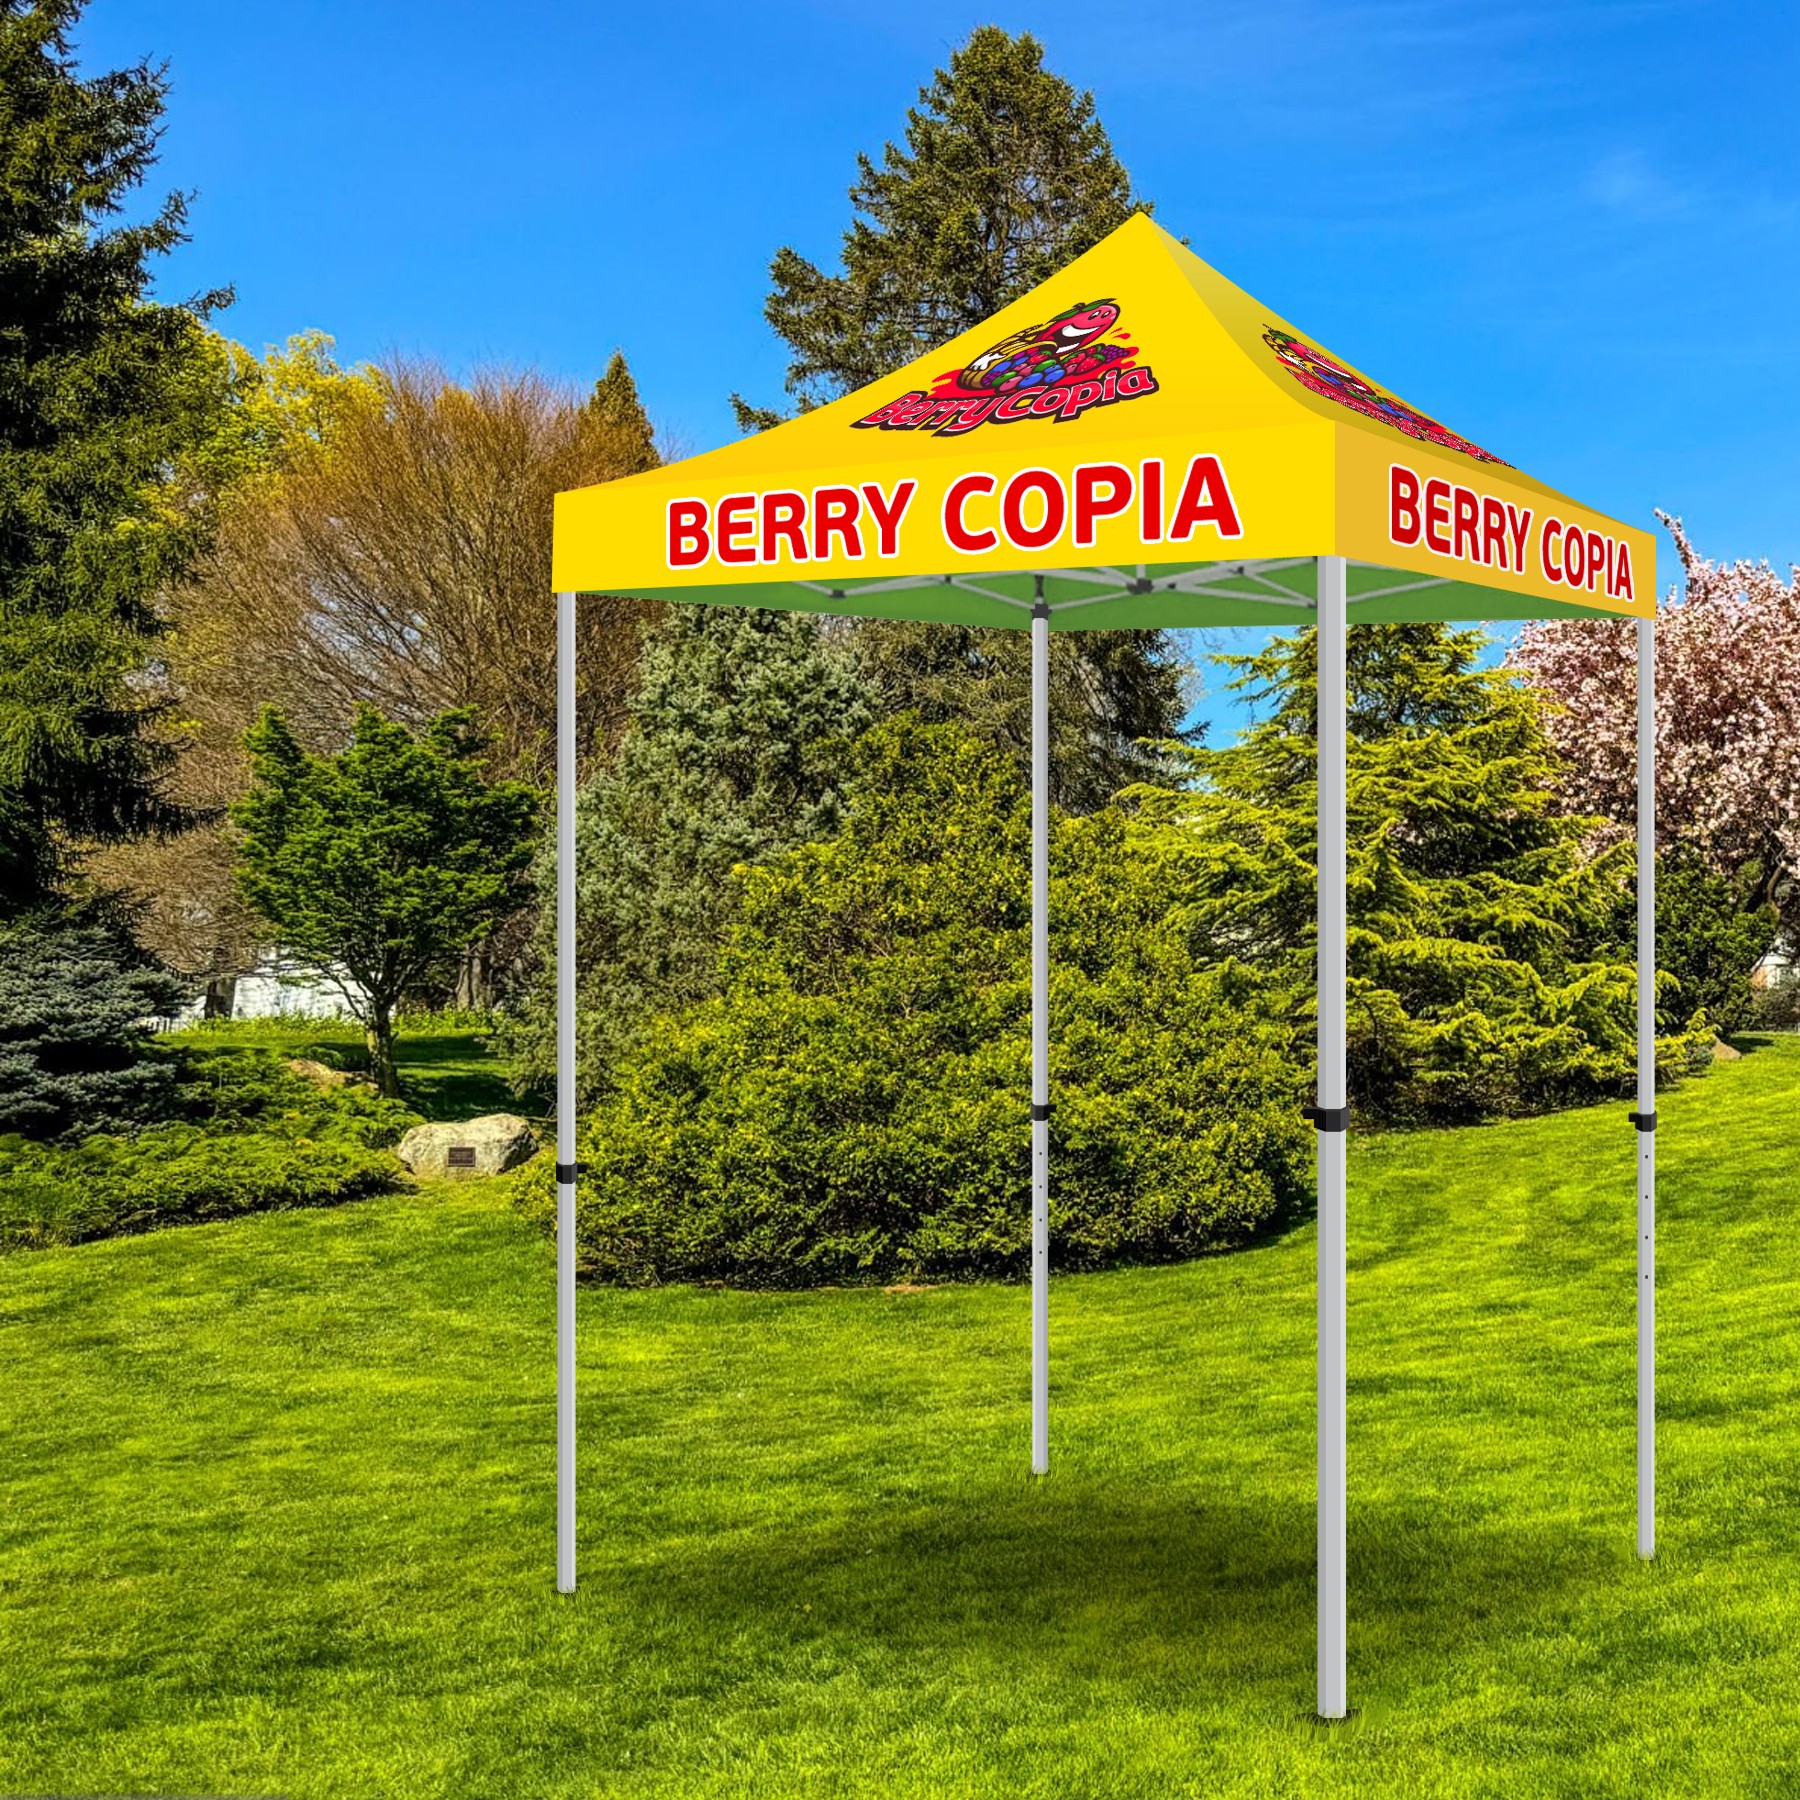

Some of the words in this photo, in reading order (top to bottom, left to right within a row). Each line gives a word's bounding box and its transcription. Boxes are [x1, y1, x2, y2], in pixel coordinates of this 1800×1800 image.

[667, 480, 918, 569] BERRY
[943, 453, 1243, 554] COPIA
[1390, 464, 1533, 575] BERRY
[1540, 516, 1635, 602] COPIA
